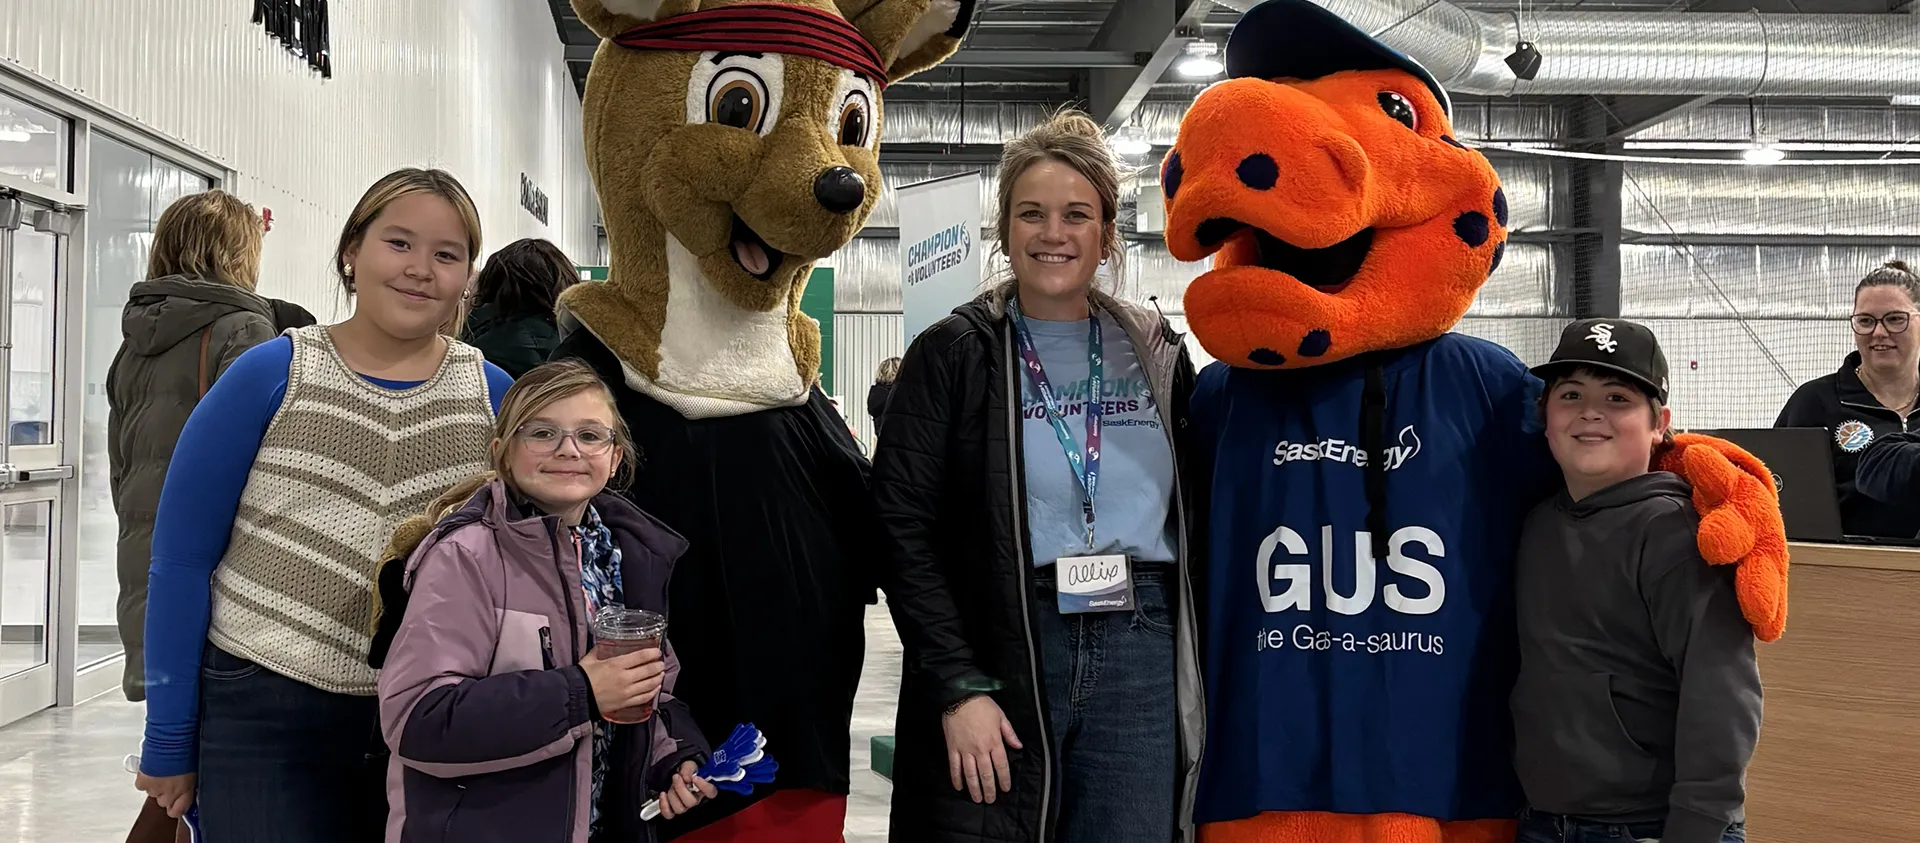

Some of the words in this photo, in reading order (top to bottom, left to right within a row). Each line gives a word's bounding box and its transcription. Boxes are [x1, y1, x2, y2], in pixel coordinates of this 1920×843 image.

[908, 224, 960, 268] CHAMPION
[914, 248, 962, 284] VOLUNTEERS
[1102, 419, 1159, 430] SaskEnergy
[1273, 436, 1413, 472] SaskEnegy
[1256, 525, 1445, 615] GUS
[1257, 627, 1284, 652] the
[1292, 624, 1444, 655] Gas-a-saurus
